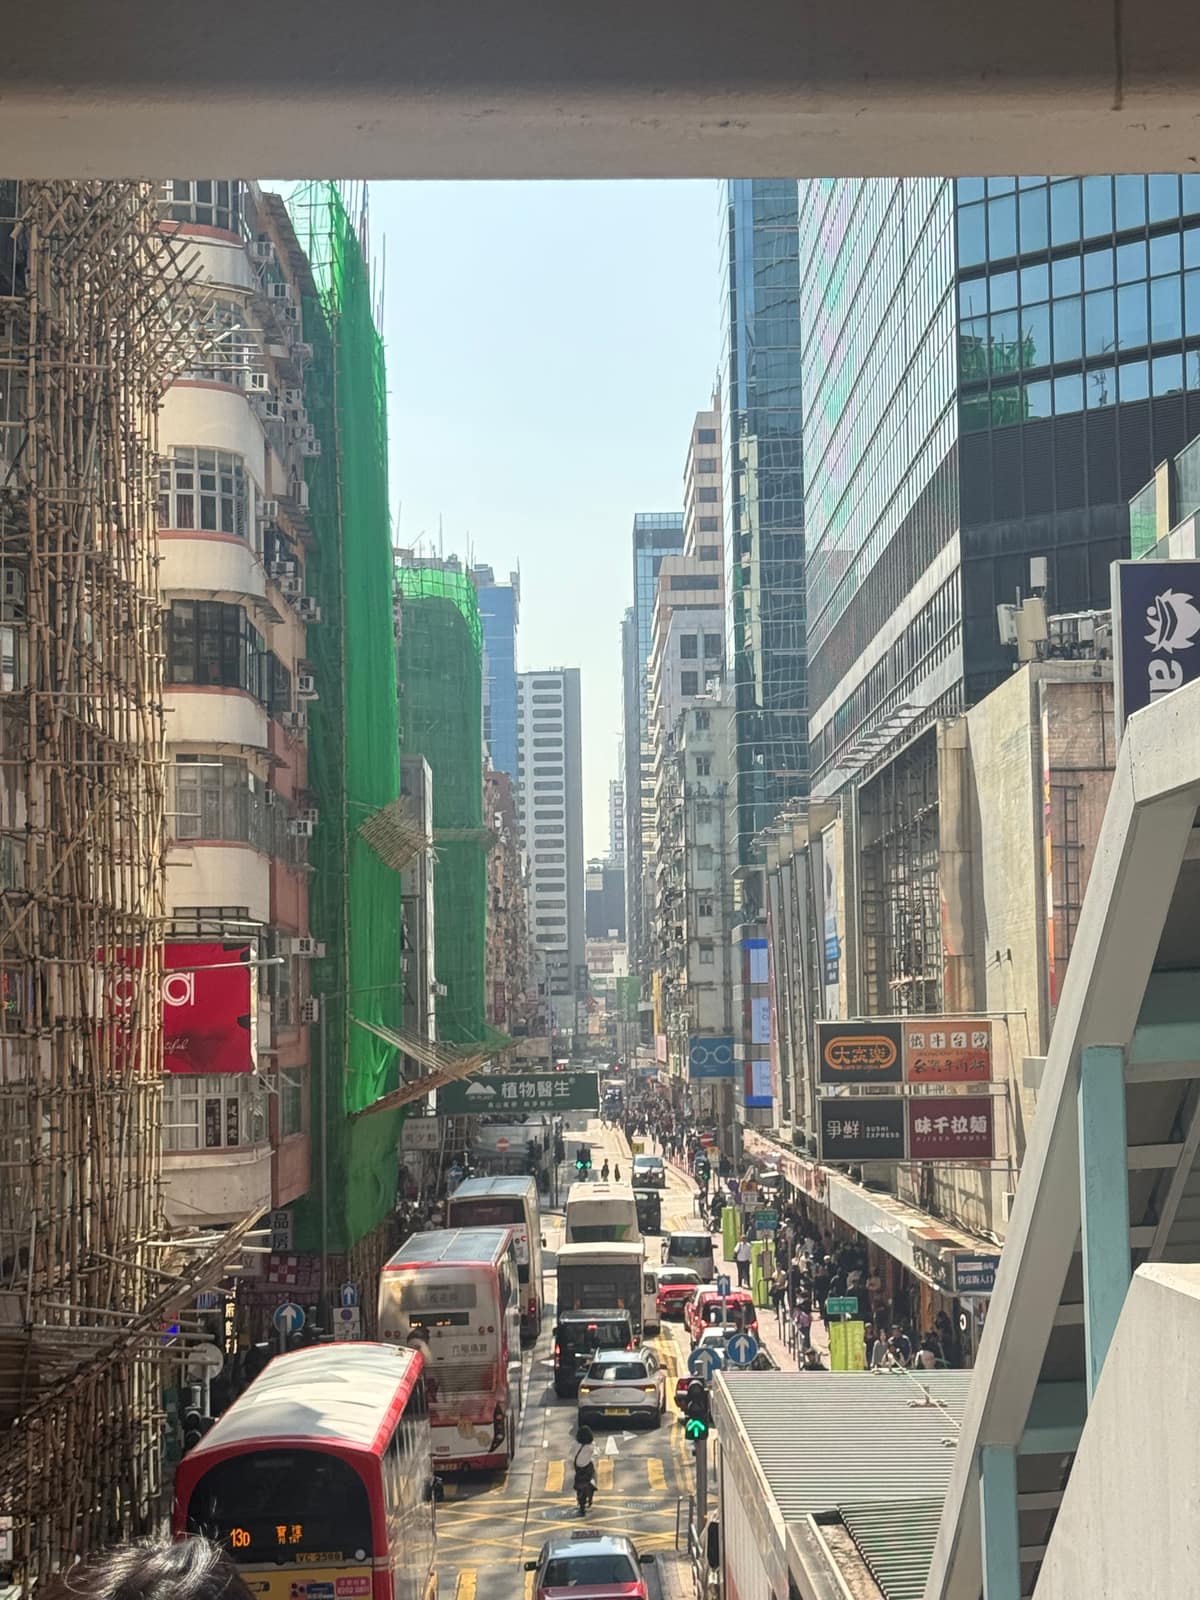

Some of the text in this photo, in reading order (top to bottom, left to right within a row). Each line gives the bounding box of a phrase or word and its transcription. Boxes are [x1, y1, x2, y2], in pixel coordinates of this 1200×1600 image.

[501, 1081, 571, 1098] 植物醫生
[914, 1115, 987, 1134] 味千拉麵
